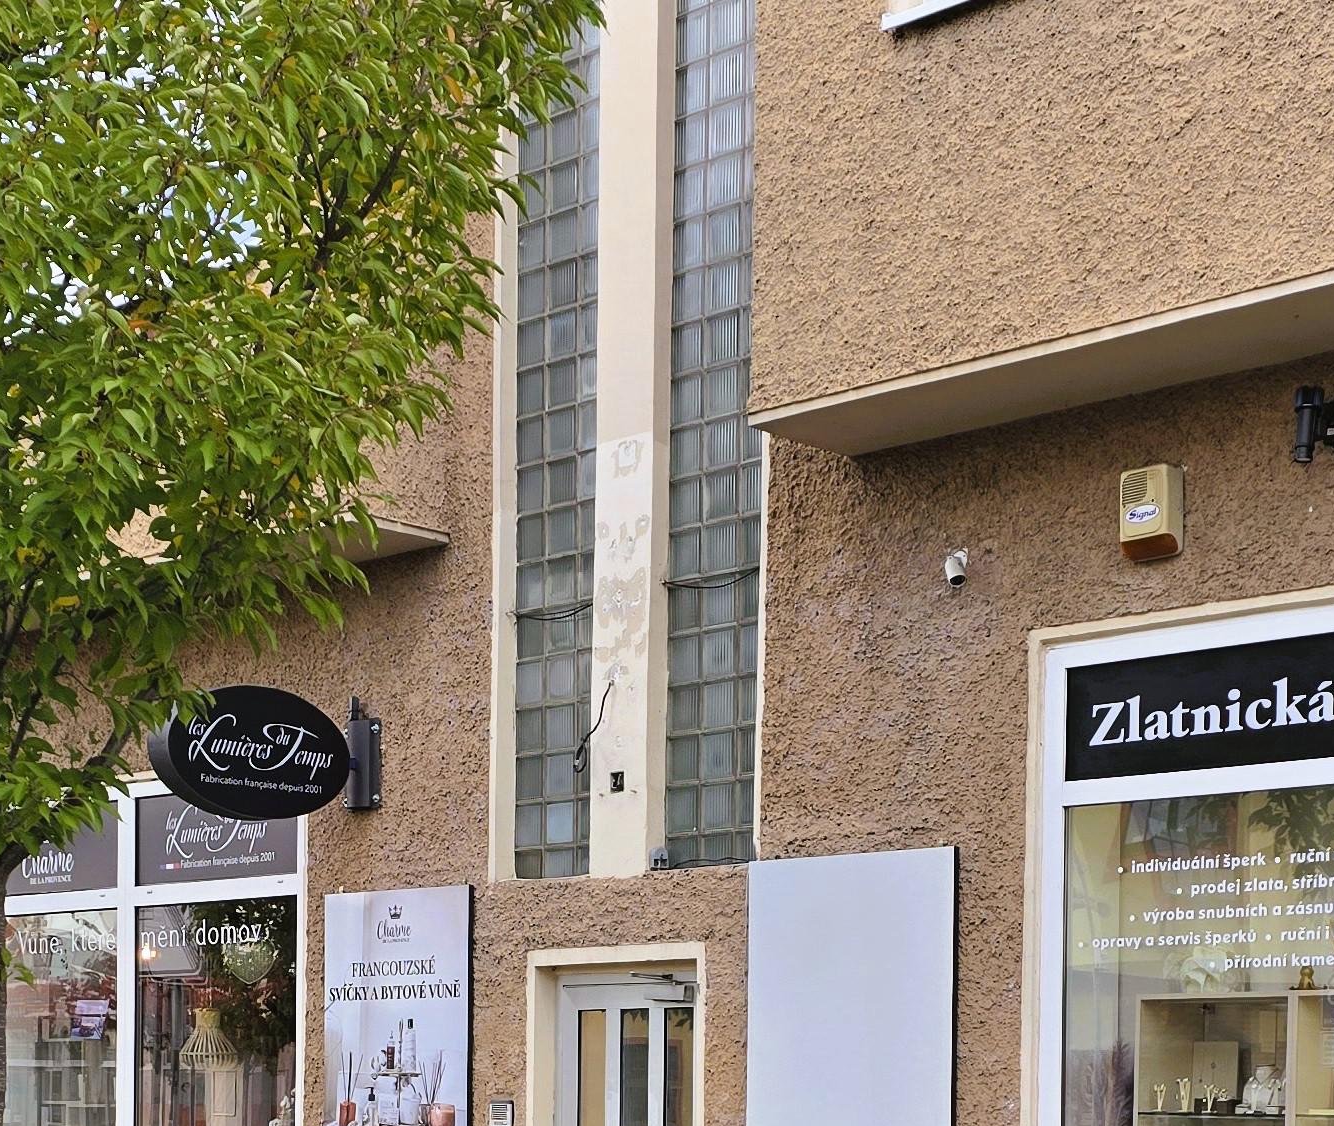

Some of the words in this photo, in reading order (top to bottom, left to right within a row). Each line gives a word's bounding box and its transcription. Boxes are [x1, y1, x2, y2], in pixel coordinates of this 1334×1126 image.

[1128, 506, 1157, 522] Signal
[188, 714, 274, 772] Lumières
[276, 727, 291, 746] du
[249, 723, 334, 781] Temps
[200, 773, 243, 787] Fabrication
[244, 777, 278, 791] française
[279, 780, 303, 793] depuis
[304, 784, 323, 795] 2001
[165, 810, 178, 831] les
[165, 805, 223, 858] Lumières
[180, 856, 211, 869] Fabrication
[212, 854, 238, 868] française
[239, 853, 260, 866] depuis
[260, 851, 276, 862] 2001
[1131, 854, 1221, 874] individuální
[1223, 852, 1267, 871] šperk
[1289, 846, 1331, 864] ruční
[1190, 878, 1241, 898] prodej
[1244, 877, 1289, 893] zlata,
[1143, 907, 1195, 925] výroba
[1198, 902, 1267, 920] snubních
[1272, 905, 1282, 916] a
[17, 930, 64, 955] Vůně,
[71, 927, 117, 952] které
[140, 924, 187, 948] mění
[194, 920, 263, 946] domov
[377, 918, 412, 940] Charme
[1092, 935, 1142, 950] opravy
[1145, 936, 1155, 946] a
[1158, 931, 1201, 946] servis
[1205, 930, 1257, 947] šperků
[1281, 925, 1322, 941] ruční
[1325, 924, 1330, 940] i
[351, 955, 436, 978] FRANCOUZSKÉ
[1224, 954, 1287, 972] přírodní
[329, 982, 370, 1002] SVÍČKY
[370, 987, 378, 1000] A
[380, 981, 427, 1000] BYTOVÉ
[429, 978, 461, 999] VŮNĚ
